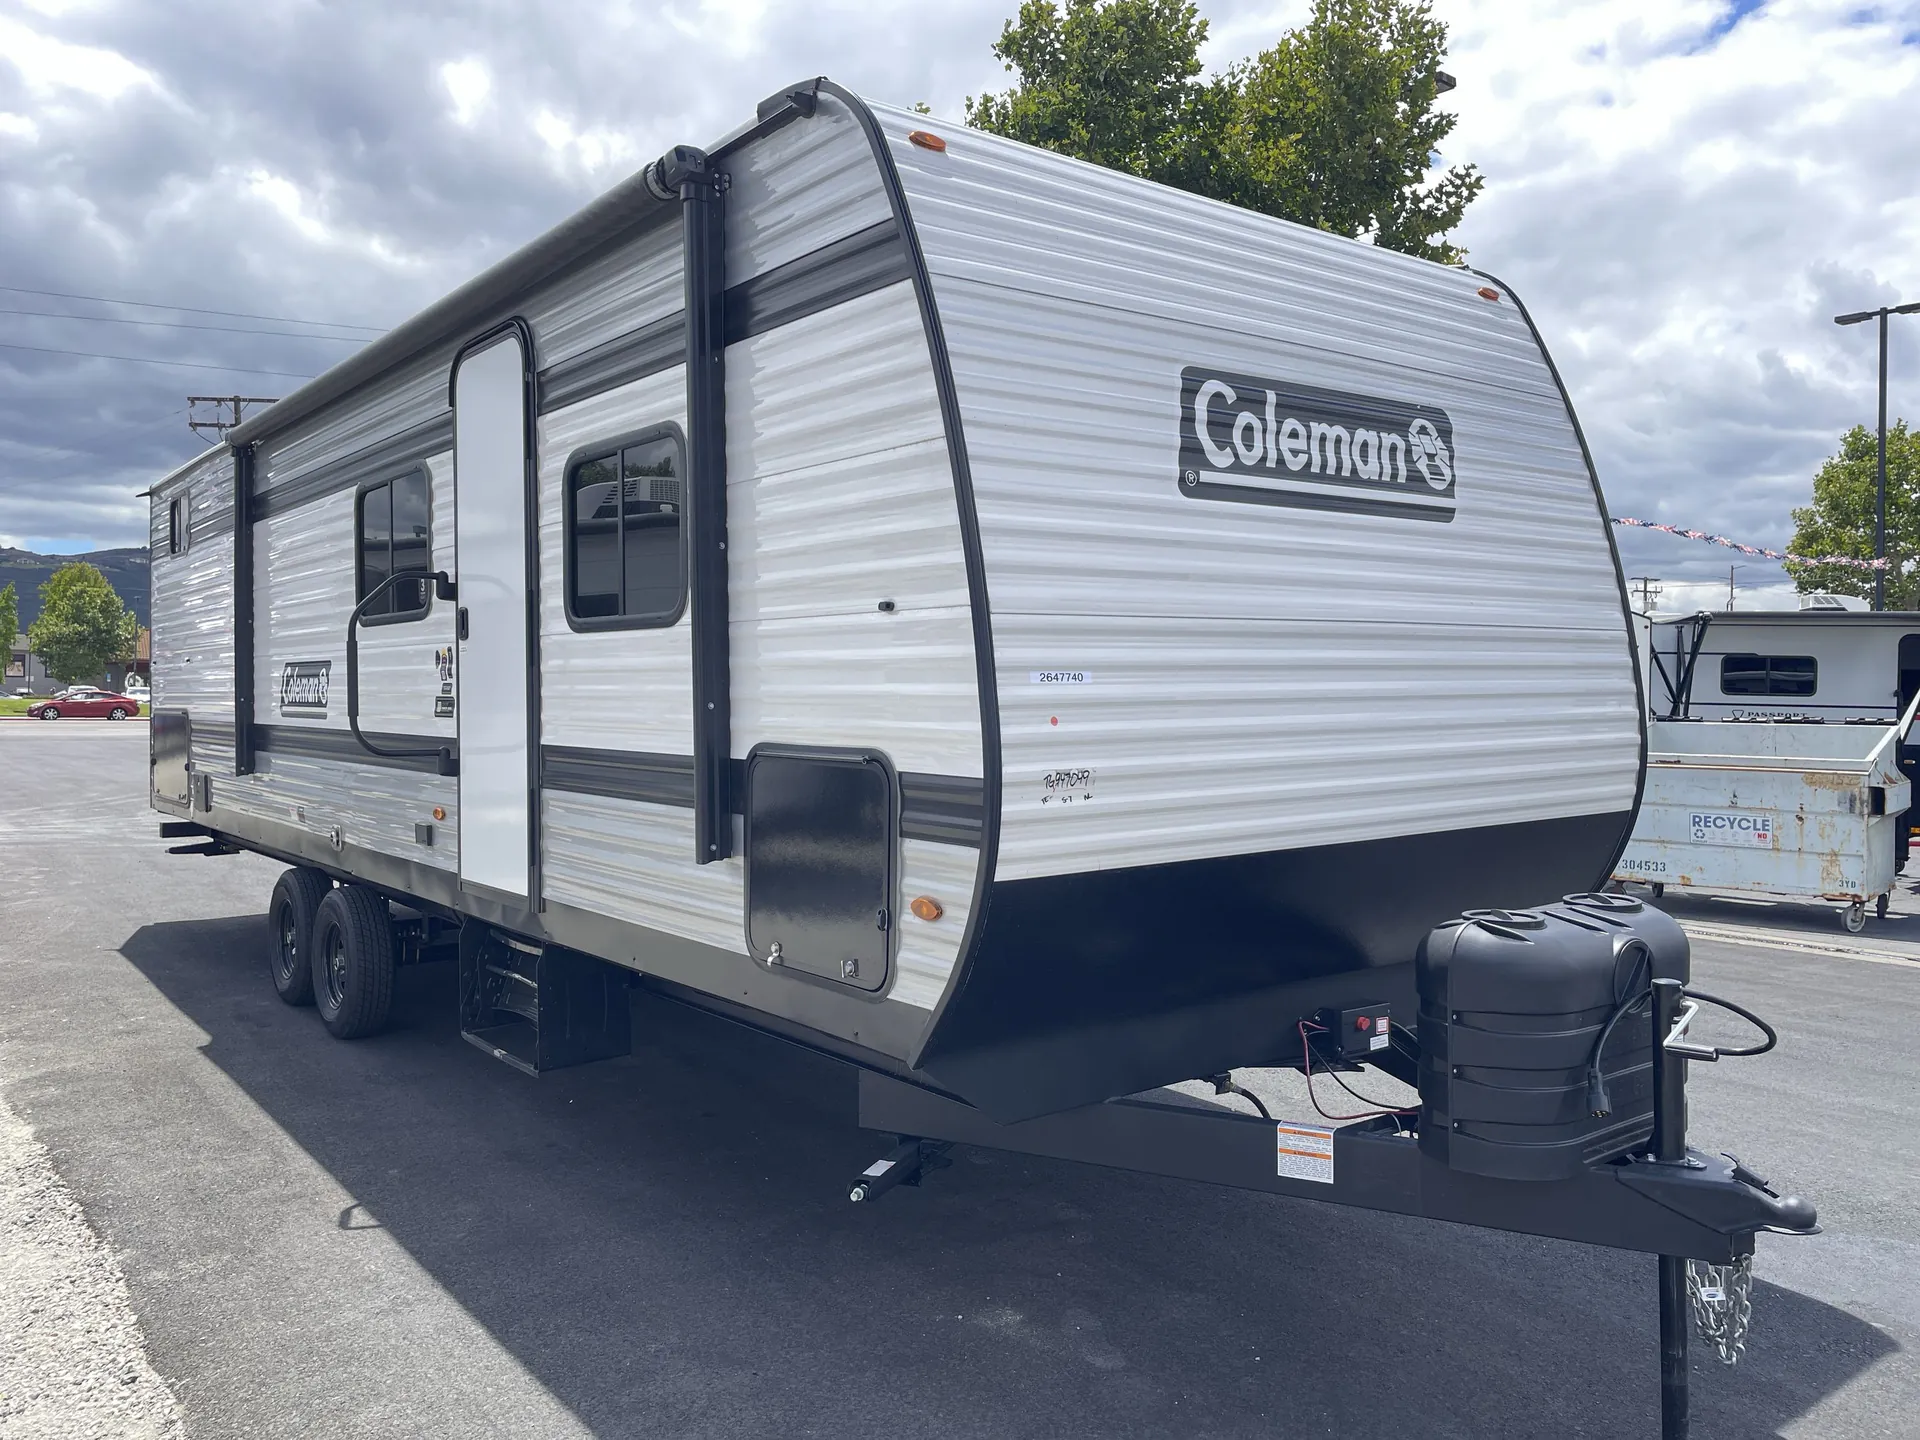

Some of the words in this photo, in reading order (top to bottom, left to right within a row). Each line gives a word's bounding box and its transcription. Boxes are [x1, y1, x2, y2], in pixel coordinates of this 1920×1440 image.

[1195, 379, 1407, 483] Coleman
[283, 666, 319, 704] Coleman
[1039, 672, 1084, 682] 2647740
[1692, 814, 1770, 832] RECYCLE
[1757, 832, 1768, 840] NO
